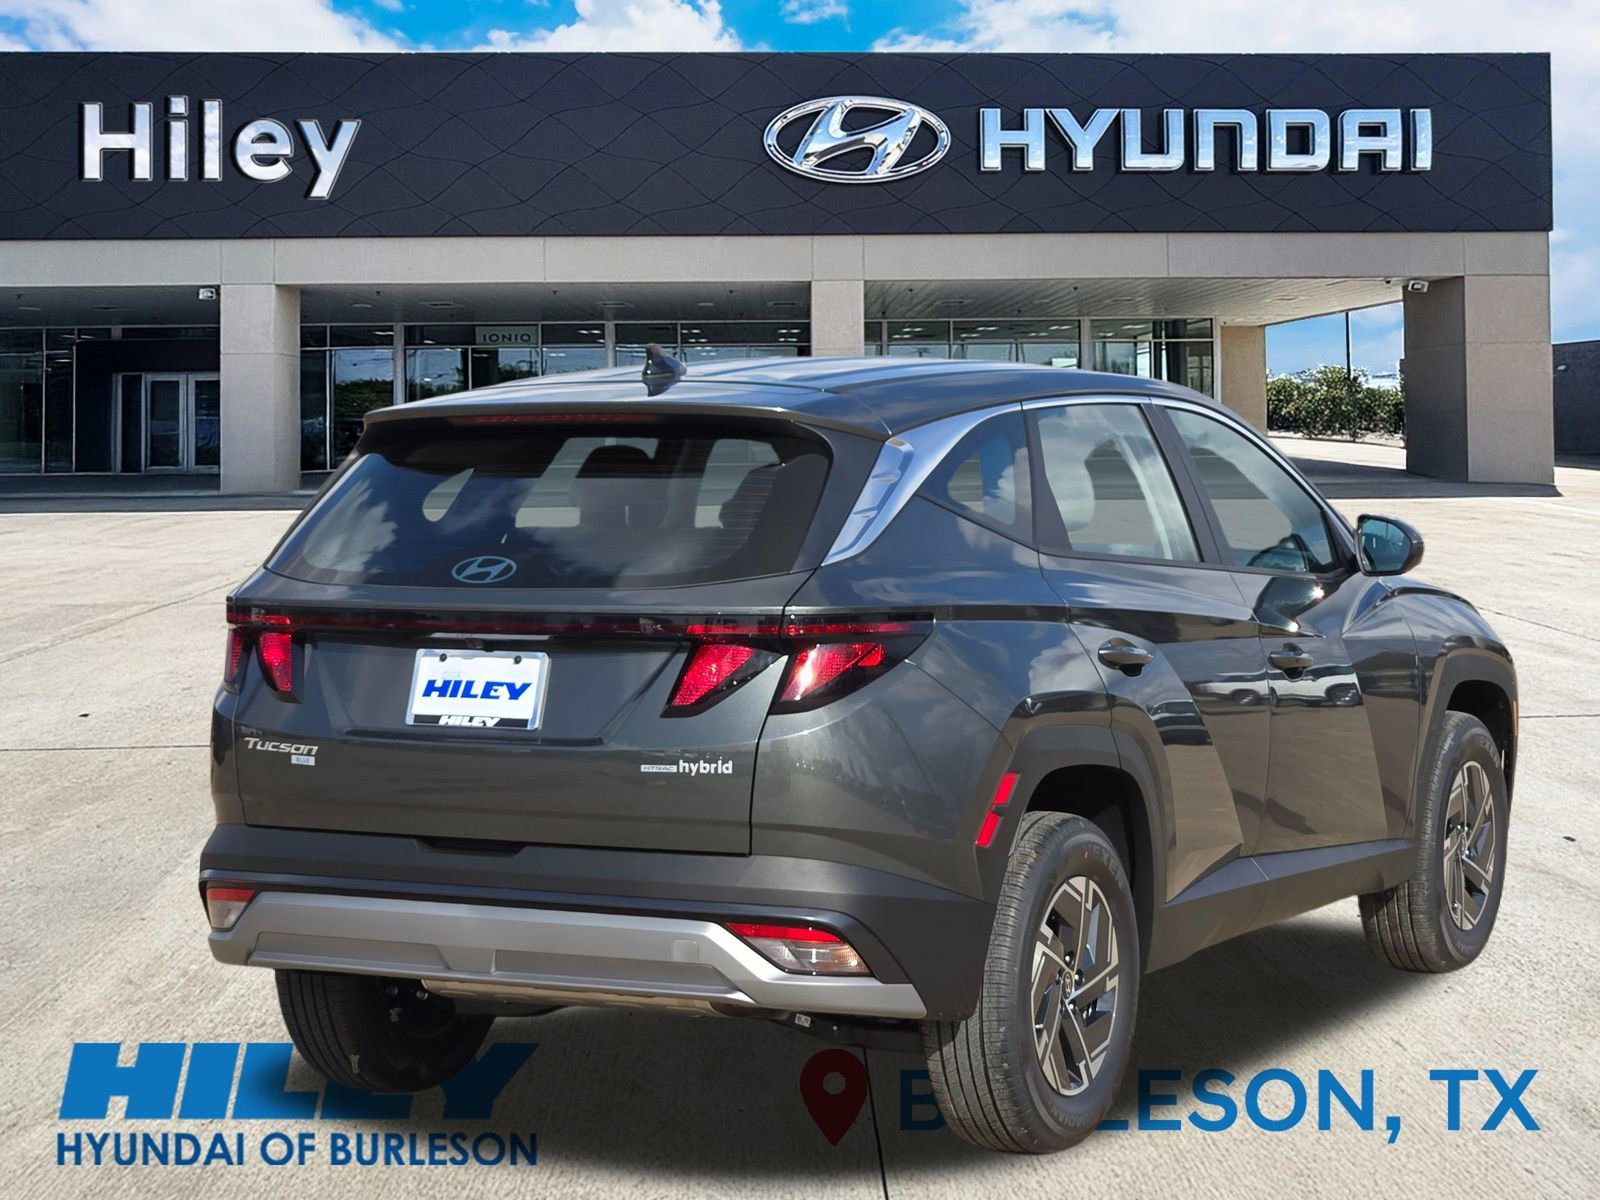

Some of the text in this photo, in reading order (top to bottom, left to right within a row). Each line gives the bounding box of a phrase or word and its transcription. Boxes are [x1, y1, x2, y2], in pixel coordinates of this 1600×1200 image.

[79, 95, 361, 199] Hiley
[979, 107, 1433, 172] HYUNDAI
[482, 332, 532, 343] IONIQ
[422, 679, 533, 700] HILEY
[438, 714, 500, 728] HILEY
[678, 756, 733, 776] hybrid
